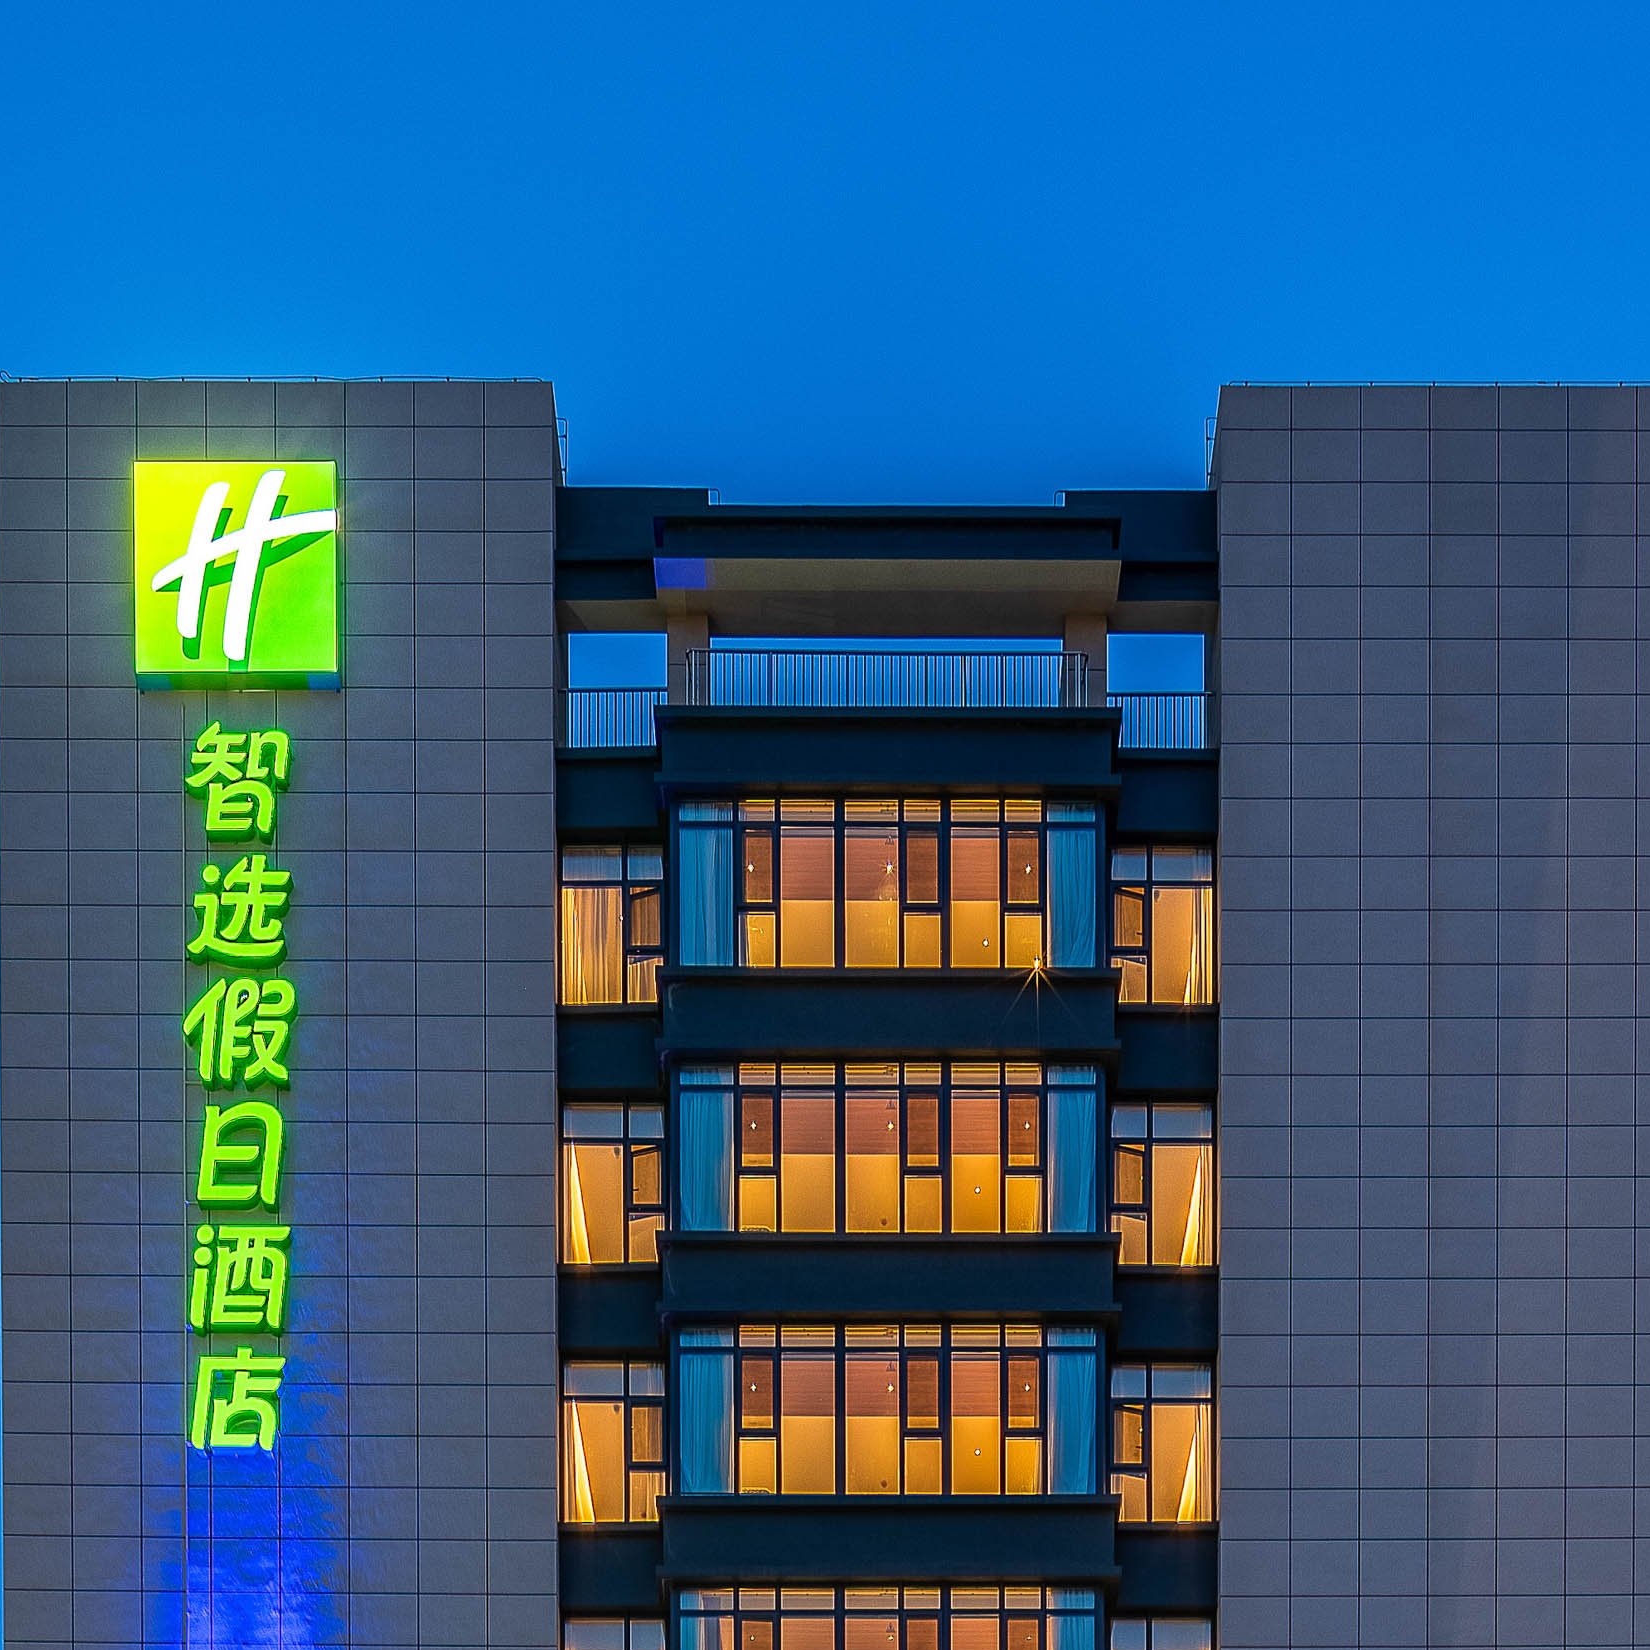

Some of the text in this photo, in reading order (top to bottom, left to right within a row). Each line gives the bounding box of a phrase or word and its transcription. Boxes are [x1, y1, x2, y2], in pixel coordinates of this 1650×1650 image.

[183, 720, 297, 1452] 智选假日酒店
